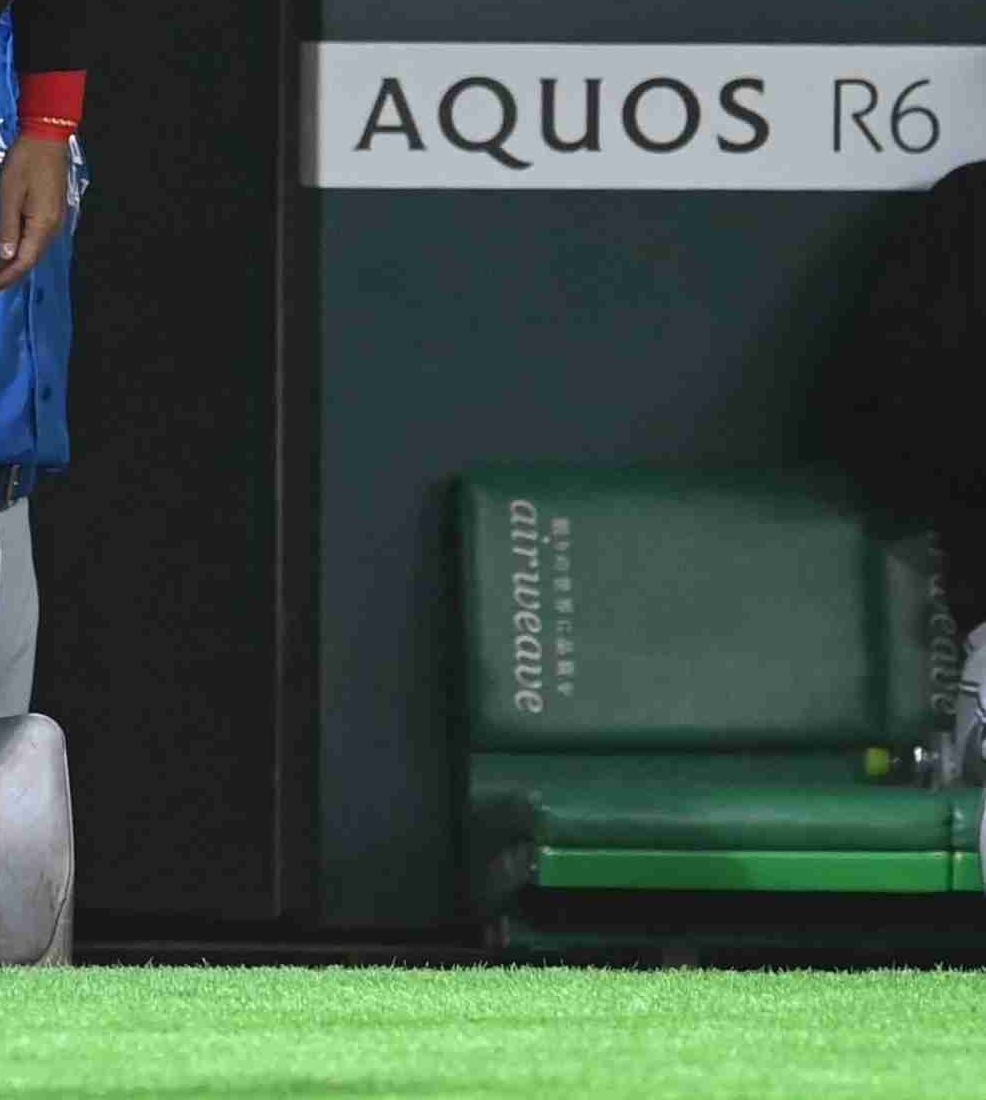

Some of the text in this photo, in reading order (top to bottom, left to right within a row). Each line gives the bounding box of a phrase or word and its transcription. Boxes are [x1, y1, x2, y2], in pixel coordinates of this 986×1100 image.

[353, 76, 941, 170] AQUOS R6
[510, 499, 550, 715] airweave
